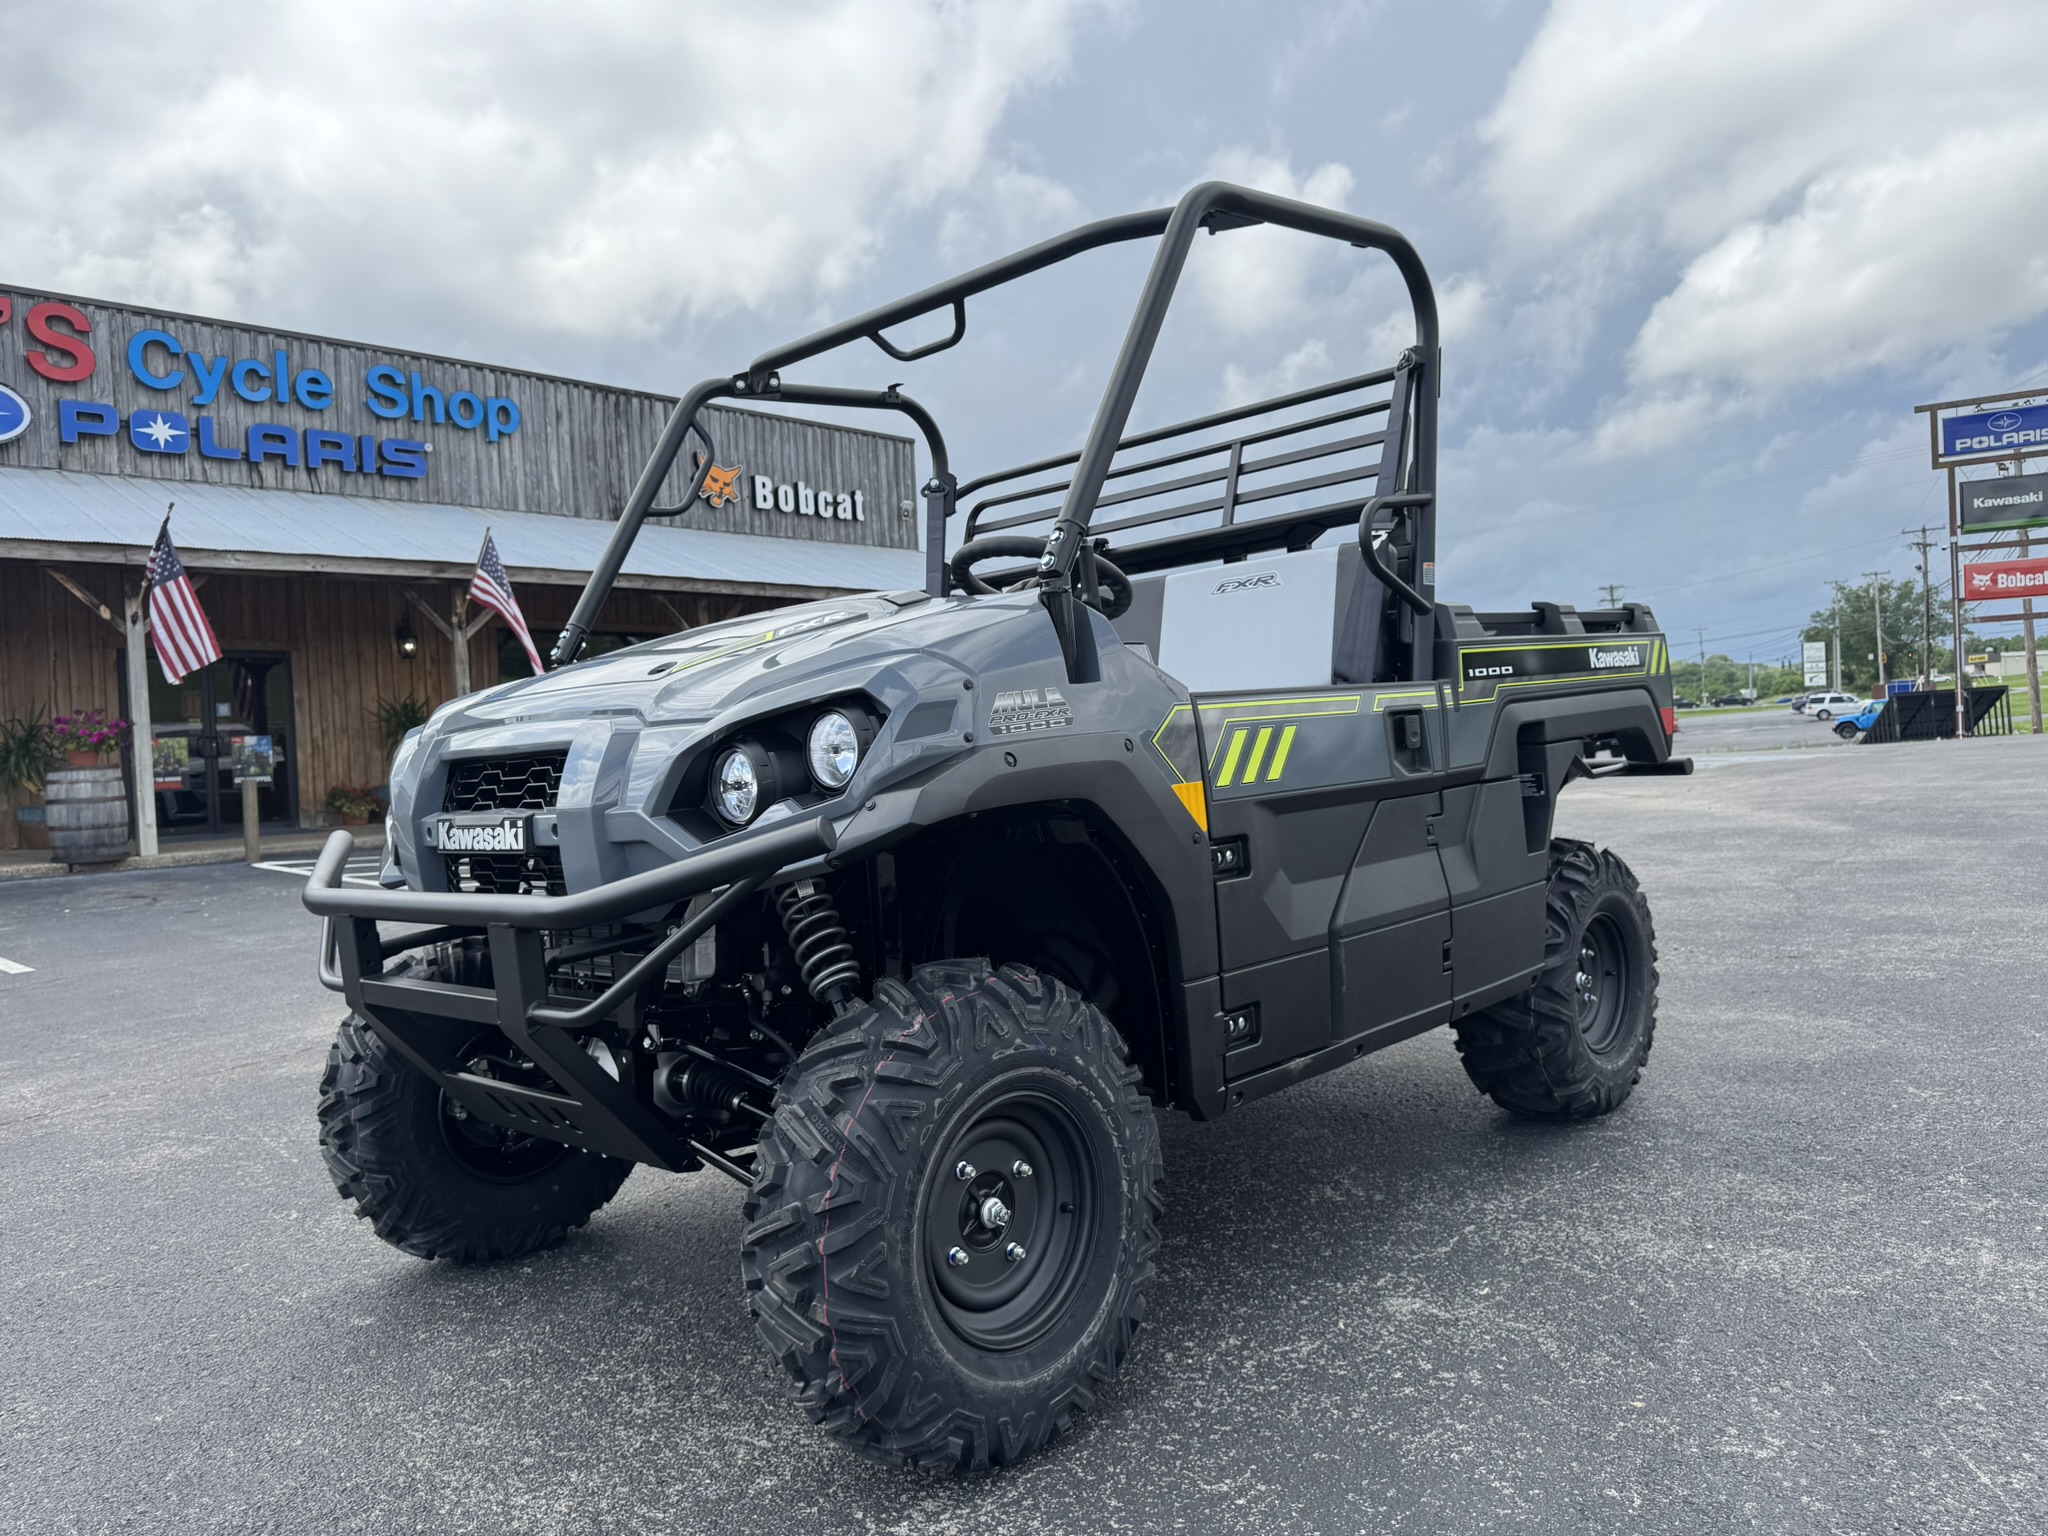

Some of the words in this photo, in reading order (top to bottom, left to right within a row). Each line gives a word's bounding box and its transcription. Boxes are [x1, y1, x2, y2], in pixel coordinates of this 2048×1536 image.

[127, 329, 334, 410] Cycle
[366, 364, 521, 442] Shop
[59, 399, 430, 479] POLARIS
[753, 474, 865, 521] Bobcat
[1973, 491, 2043, 509] Kawasaki
[1214, 574, 1279, 593] FXR
[1997, 570, 2048, 588] Bobcat
[1588, 646, 1640, 669] Kawasaki
[1467, 665, 1513, 677] 1000
[991, 686, 1070, 715] MULE
[989, 707, 1072, 725] PRO-FXR
[1000, 718, 1067, 734] 1000
[437, 819, 525, 851] Kawasaki
